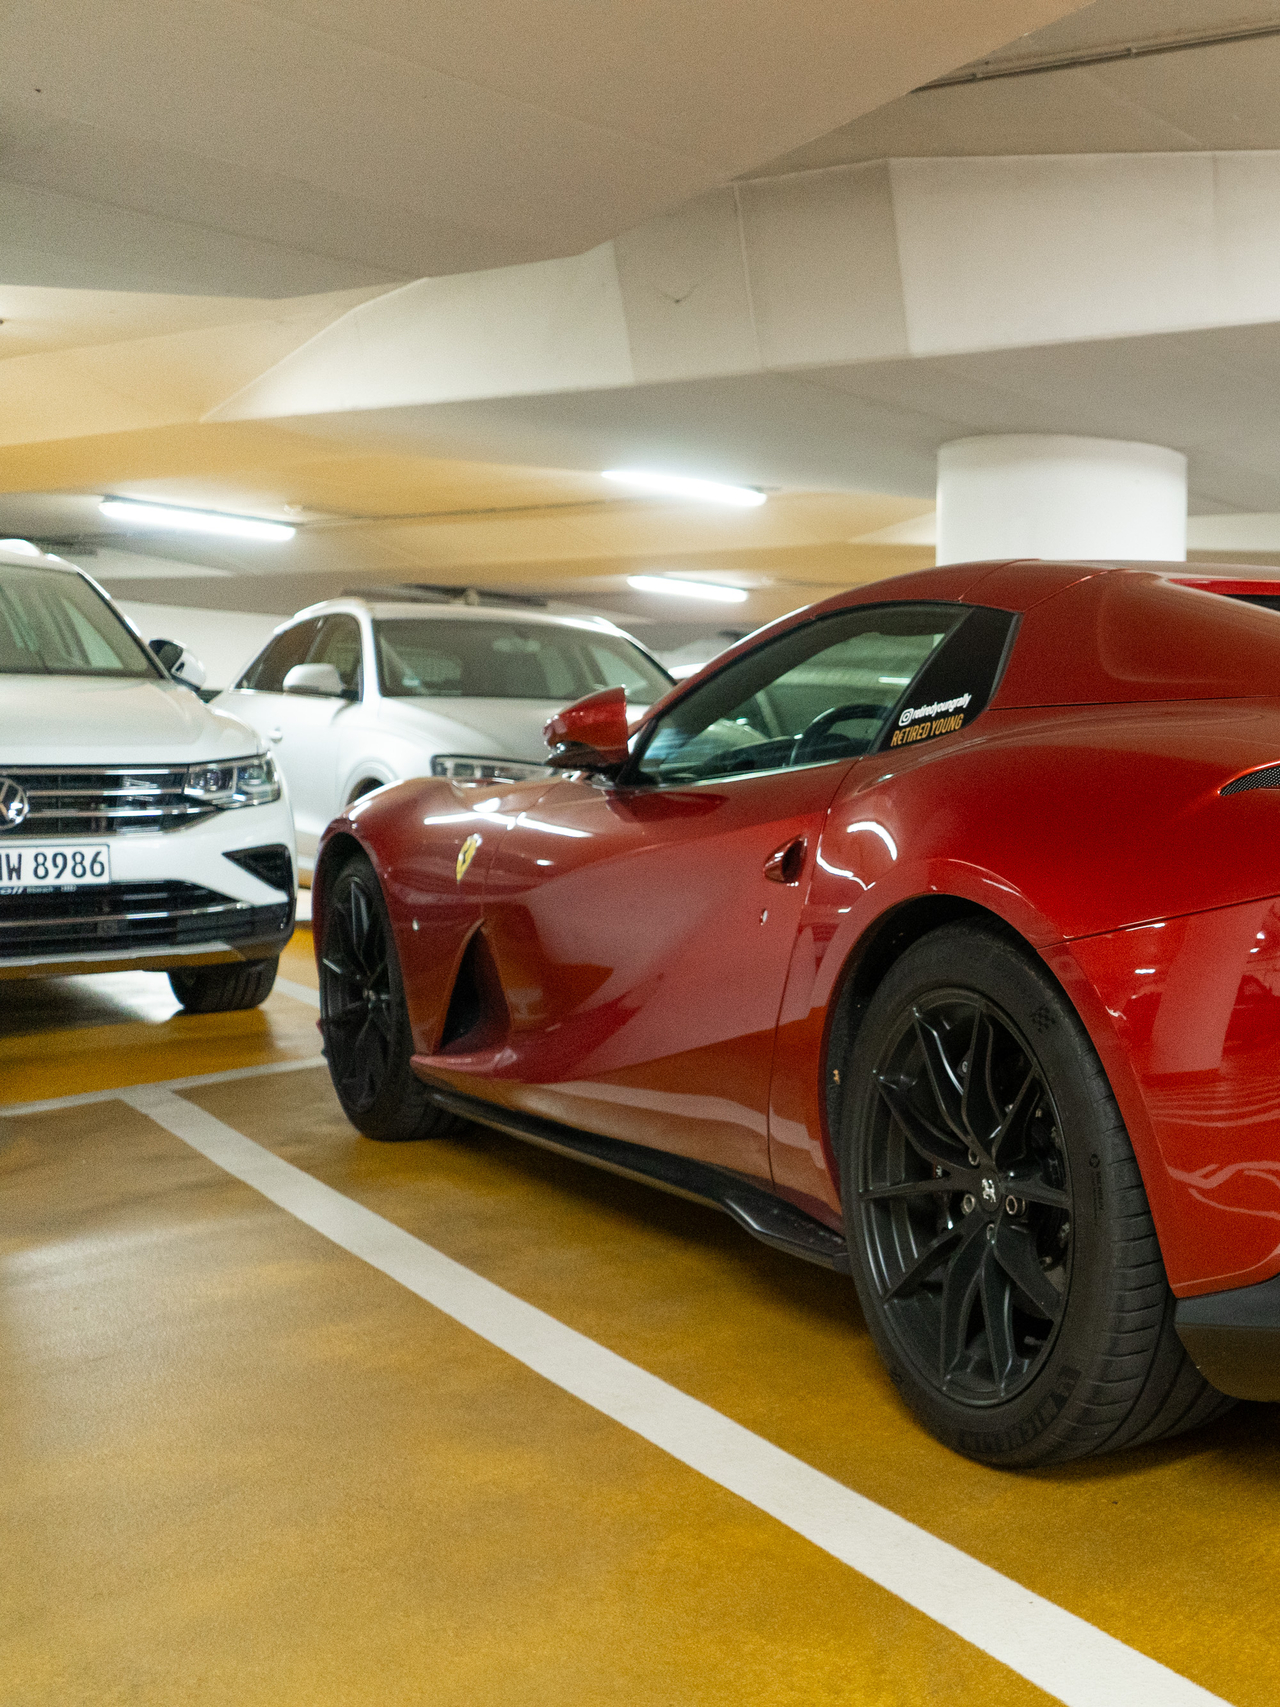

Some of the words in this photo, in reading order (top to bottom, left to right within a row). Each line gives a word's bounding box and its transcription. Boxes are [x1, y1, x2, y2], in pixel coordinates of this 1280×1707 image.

[891, 721, 931, 746] RETIRED
[930, 713, 965, 737] YOUNG
[0, 853, 22, 881] W
[33, 850, 105, 880] 8986
